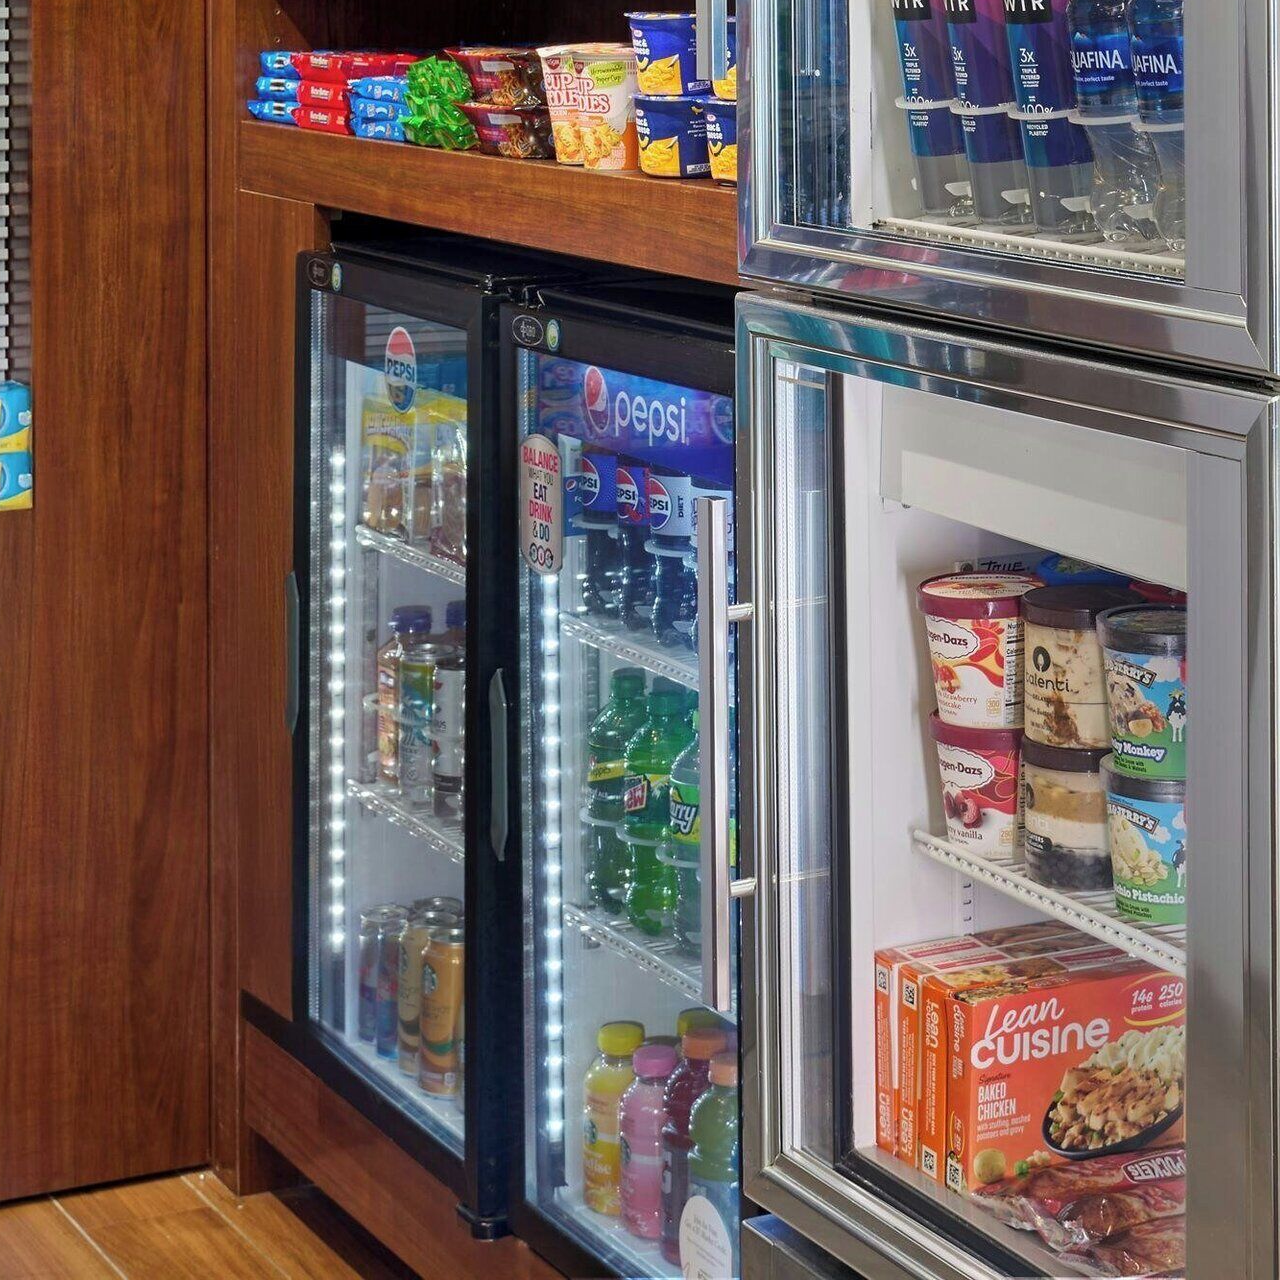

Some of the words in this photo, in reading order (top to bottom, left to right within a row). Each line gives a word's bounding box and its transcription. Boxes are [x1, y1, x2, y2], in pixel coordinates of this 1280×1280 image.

[903, 43, 917, 57] 3x
[952, 46, 964, 61] 3x
[1020, 48, 1035, 63] 3x
[386, 356, 416, 384] PEPSI
[614, 390, 689, 448] pepsi
[523, 445, 559, 474] BALANCE
[533, 482, 548, 503] EAT
[528, 499, 553, 525] DRINK
[539, 523, 550, 542] DO
[1123, 741, 1165, 761] Monkey
[957, 829, 984, 841] vanilla
[1132, 888, 1186, 905] Pistachio
[1159, 982, 1184, 1001] 250
[985, 997, 1065, 1044] Lean
[978, 1082, 1007, 1104] BAKED
[977, 1098, 1017, 1122] CHICKEN
